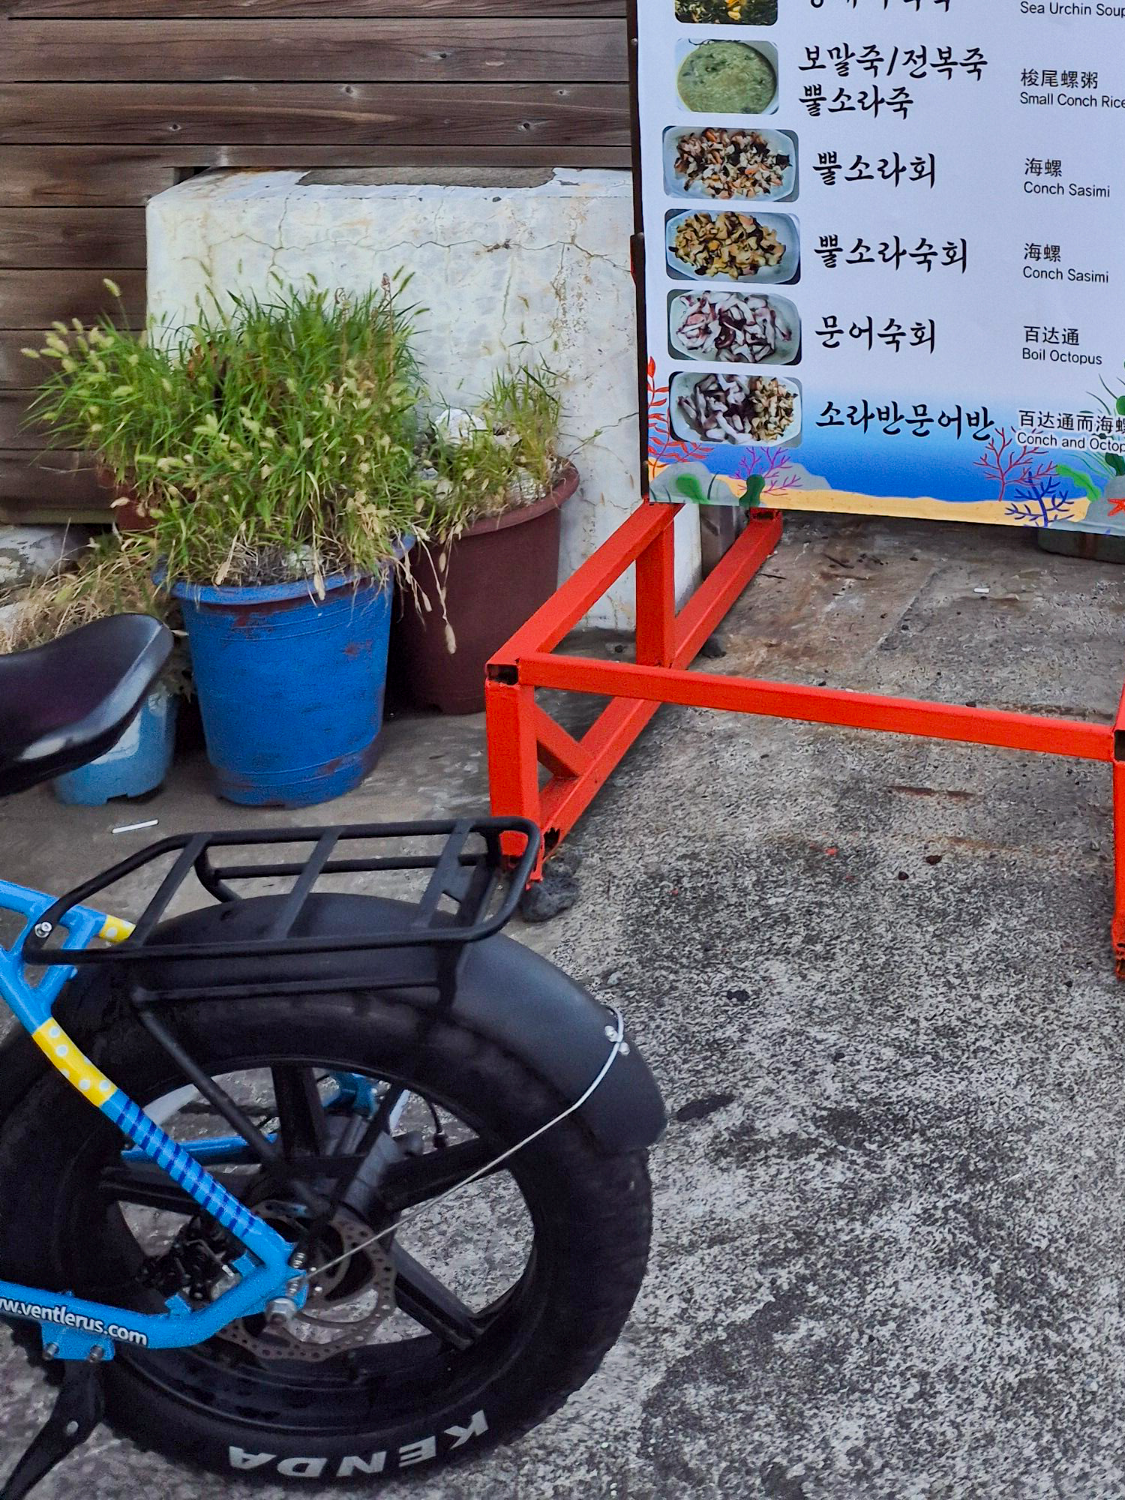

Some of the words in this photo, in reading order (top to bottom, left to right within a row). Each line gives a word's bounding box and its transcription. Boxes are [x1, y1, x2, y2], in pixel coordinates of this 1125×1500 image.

[1021, 1, 1044, 13] Sea
[1050, 2, 1091, 15] Urchin
[799, 43, 988, 81] 보말죽/전복죽
[1021, 69, 1098, 89] 梭尾螺粥
[799, 84, 913, 120] 뿔소라죽
[1020, 92, 1053, 105] Small
[1057, 93, 1097, 107] Conch
[813, 151, 935, 188] 뿔소라회
[1025, 158, 1062, 177] 海螺
[1024, 181, 1064, 194] Conch
[1069, 183, 1109, 197] Sasimi
[814, 234, 966, 273] 뿔소라숙회
[1024, 243, 1061, 262] 海螺
[1023, 266, 1063, 280] Conch
[1068, 269, 1108, 283] Sasimi
[815, 316, 935, 353] 문어숙회
[1024, 326, 1079, 345] 百达通
[1023, 348, 1045, 360] Boil
[1050, 350, 1102, 365] Octopus
[815, 400, 995, 441] 소라반문어반
[1017, 432, 1058, 447] Conch
[1062, 435, 1085, 449] and
[0, 1298, 148, 1346] w.ventlerus.com
[229, 1410, 489, 1477] KENDA
